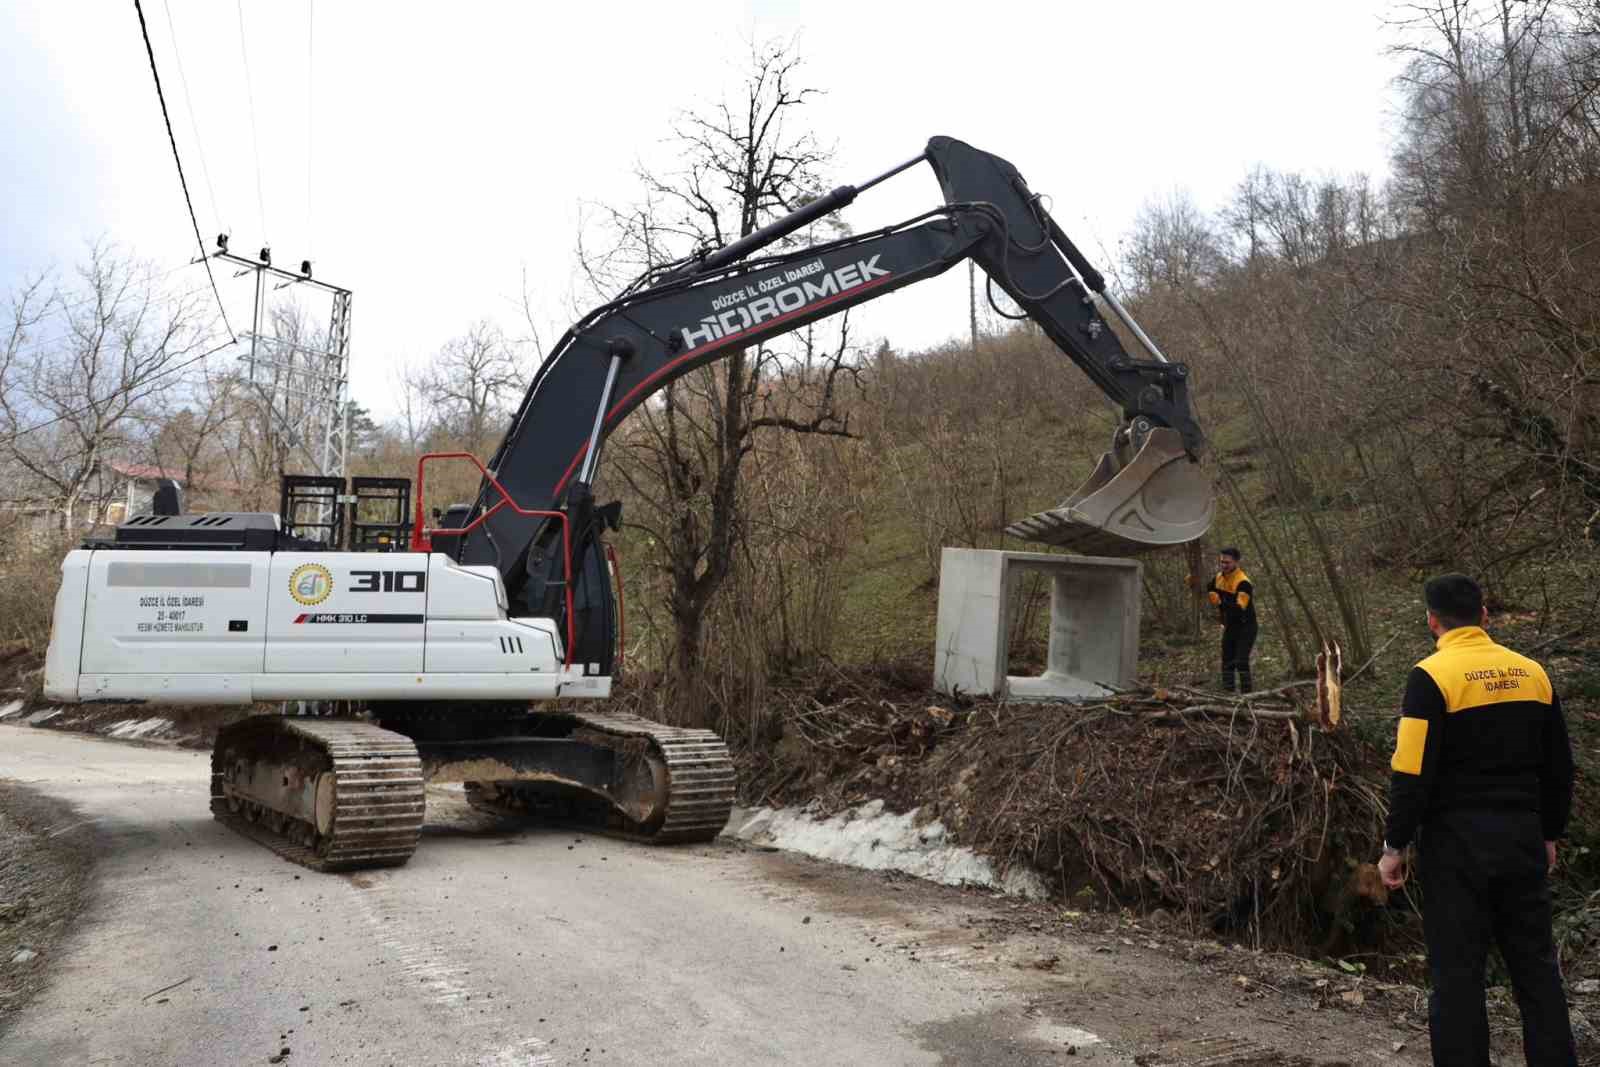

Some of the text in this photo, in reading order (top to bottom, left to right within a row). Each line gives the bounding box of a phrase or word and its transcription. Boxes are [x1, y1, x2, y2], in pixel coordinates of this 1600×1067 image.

[758, 276, 784, 294] ÖZEL
[784, 258, 825, 283] İDARESİ
[680, 254, 892, 350] HİDROMEK
[348, 570, 426, 592] 310
[338, 614, 354, 623] 310
